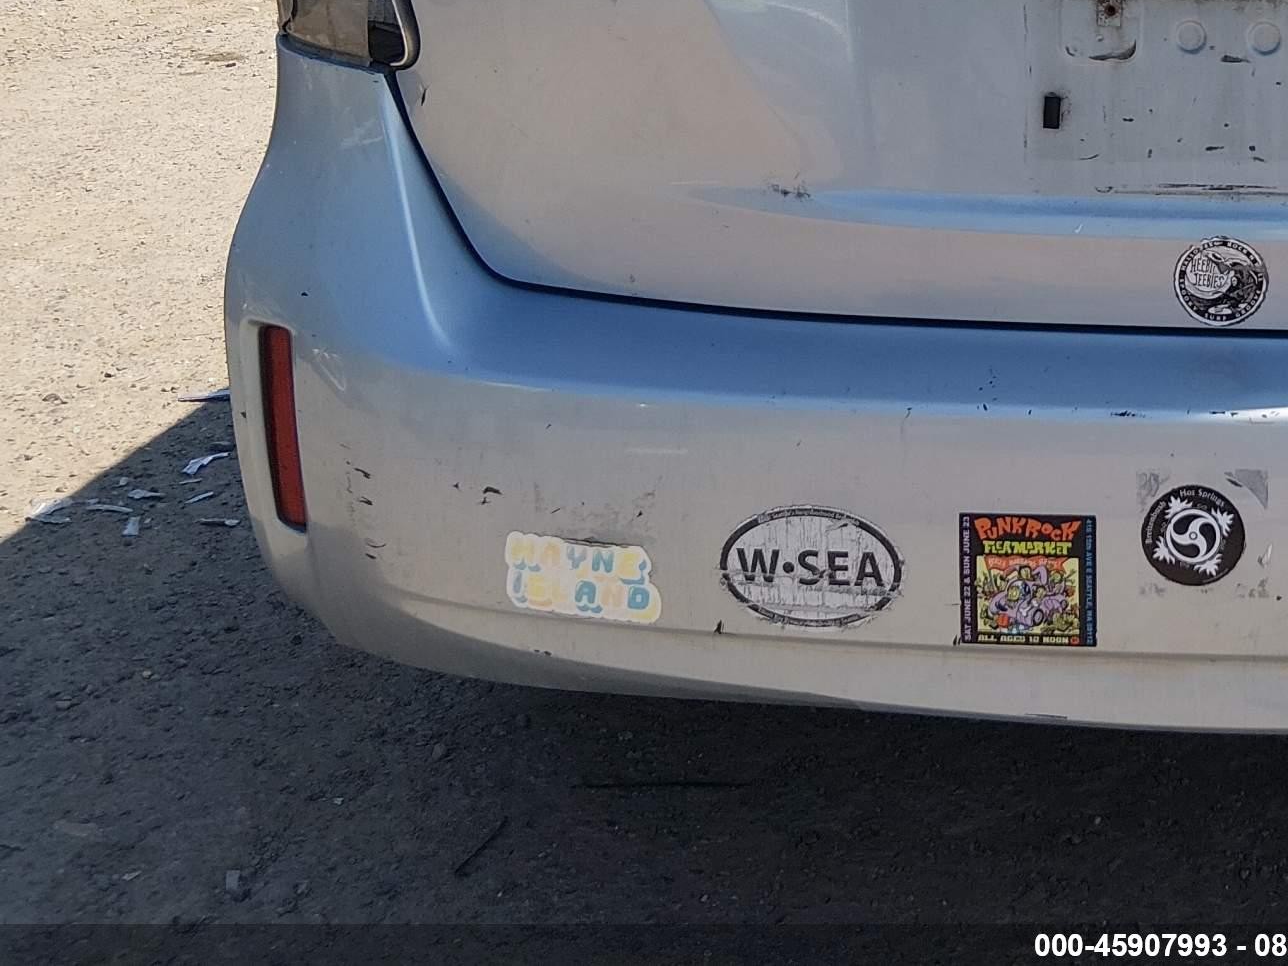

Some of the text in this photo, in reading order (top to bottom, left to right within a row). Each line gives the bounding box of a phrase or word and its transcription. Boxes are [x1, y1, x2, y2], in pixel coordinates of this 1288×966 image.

[973, 516, 1081, 541] PUNK ROCK
[962, 516, 972, 641] SAT JUNE 22 & SUN JUNE 23
